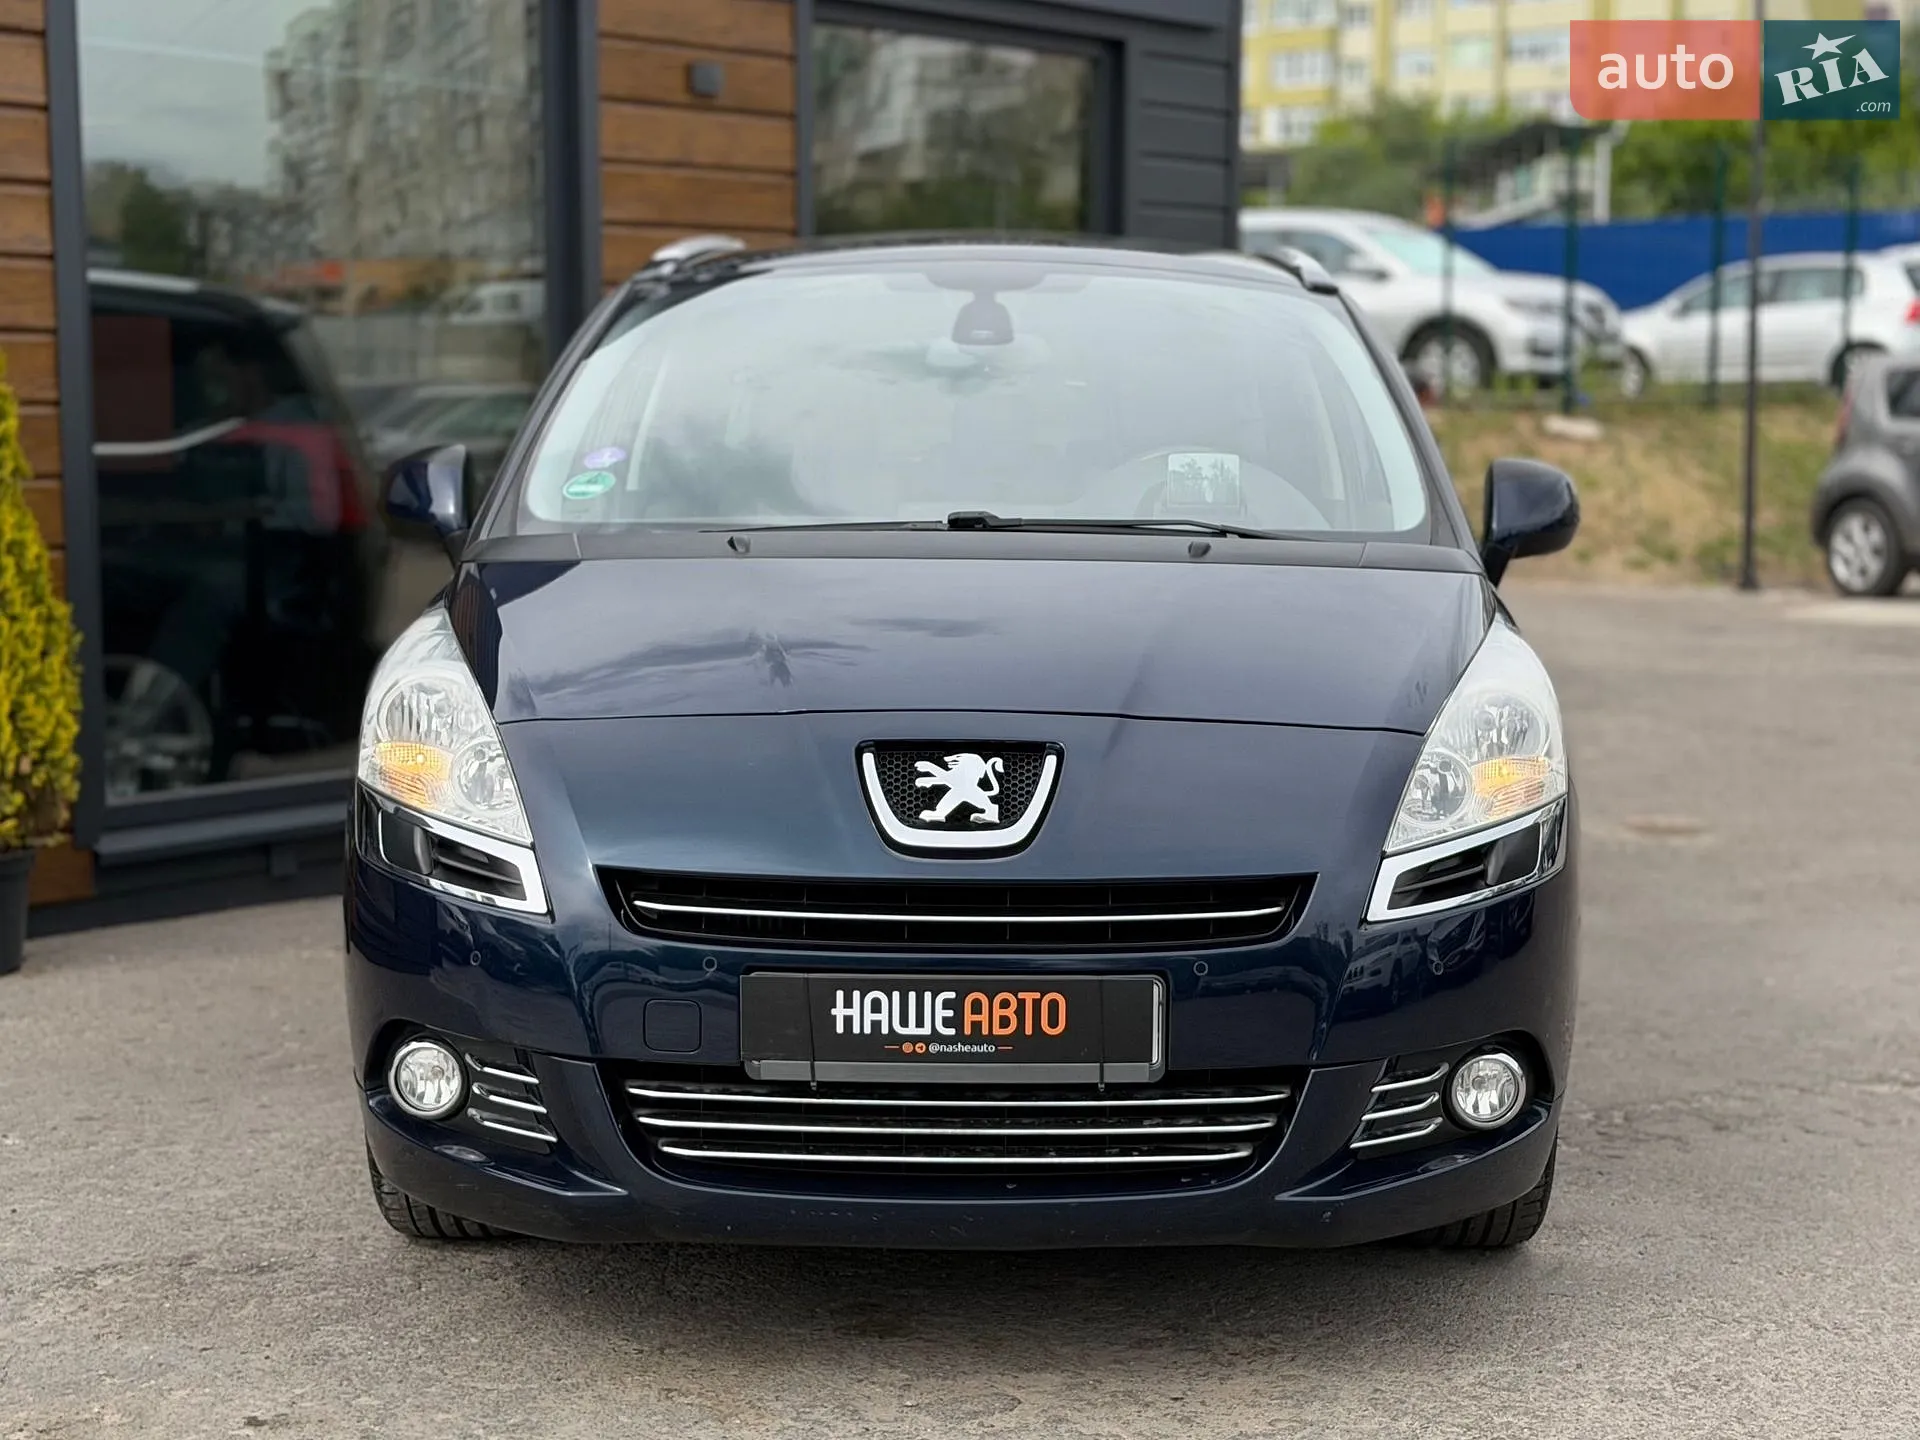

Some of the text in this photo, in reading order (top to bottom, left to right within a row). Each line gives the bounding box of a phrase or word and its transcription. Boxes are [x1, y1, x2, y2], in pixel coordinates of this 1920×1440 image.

[831, 989, 1067, 1036] НАШЕ АВТО
[928, 1042, 996, 1054] @nasheauto
